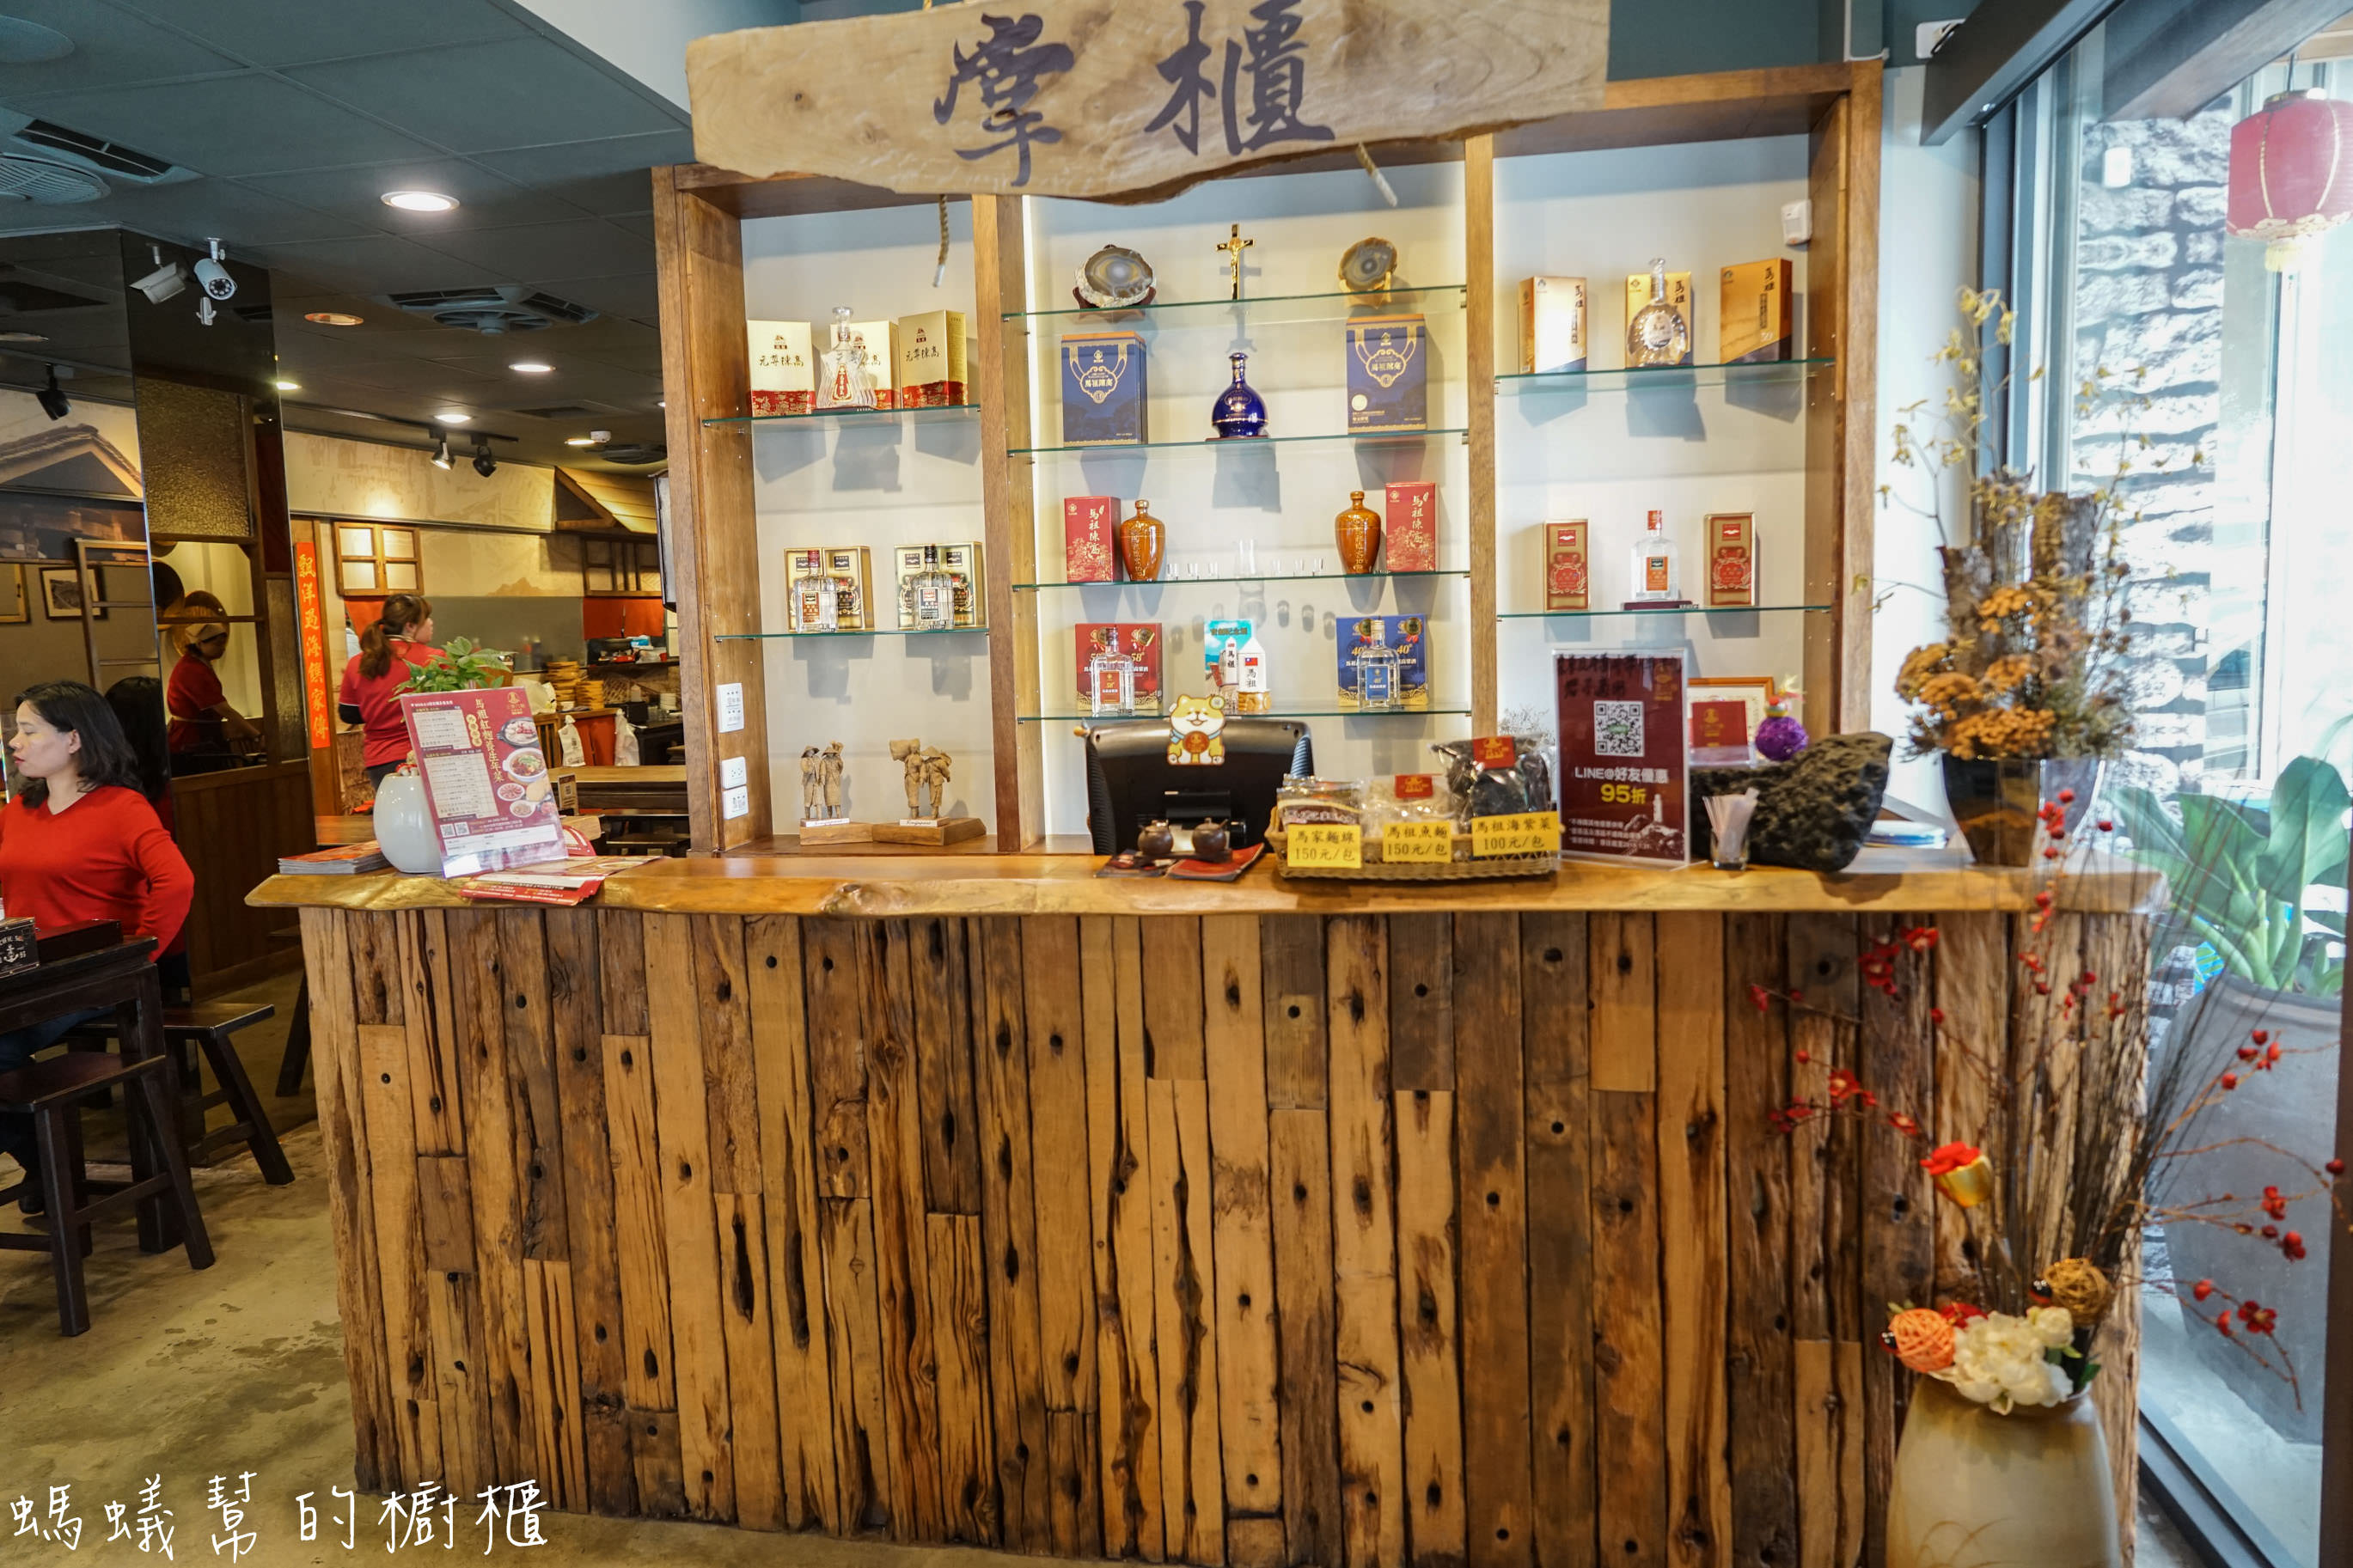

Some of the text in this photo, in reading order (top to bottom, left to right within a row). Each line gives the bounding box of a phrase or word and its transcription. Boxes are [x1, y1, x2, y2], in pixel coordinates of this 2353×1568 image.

[933, 0, 1335, 186] 掌櫃
[1574, 766, 1670, 784] LINE@好友優惠
[1600, 783, 1647, 805] 95折
[1475, 817, 1551, 833] 馬祖海紫菜
[1387, 843, 1448, 857] 150元/包
[1483, 834, 1545, 851] 100元/包
[1295, 847, 1355, 862] 150元/包
